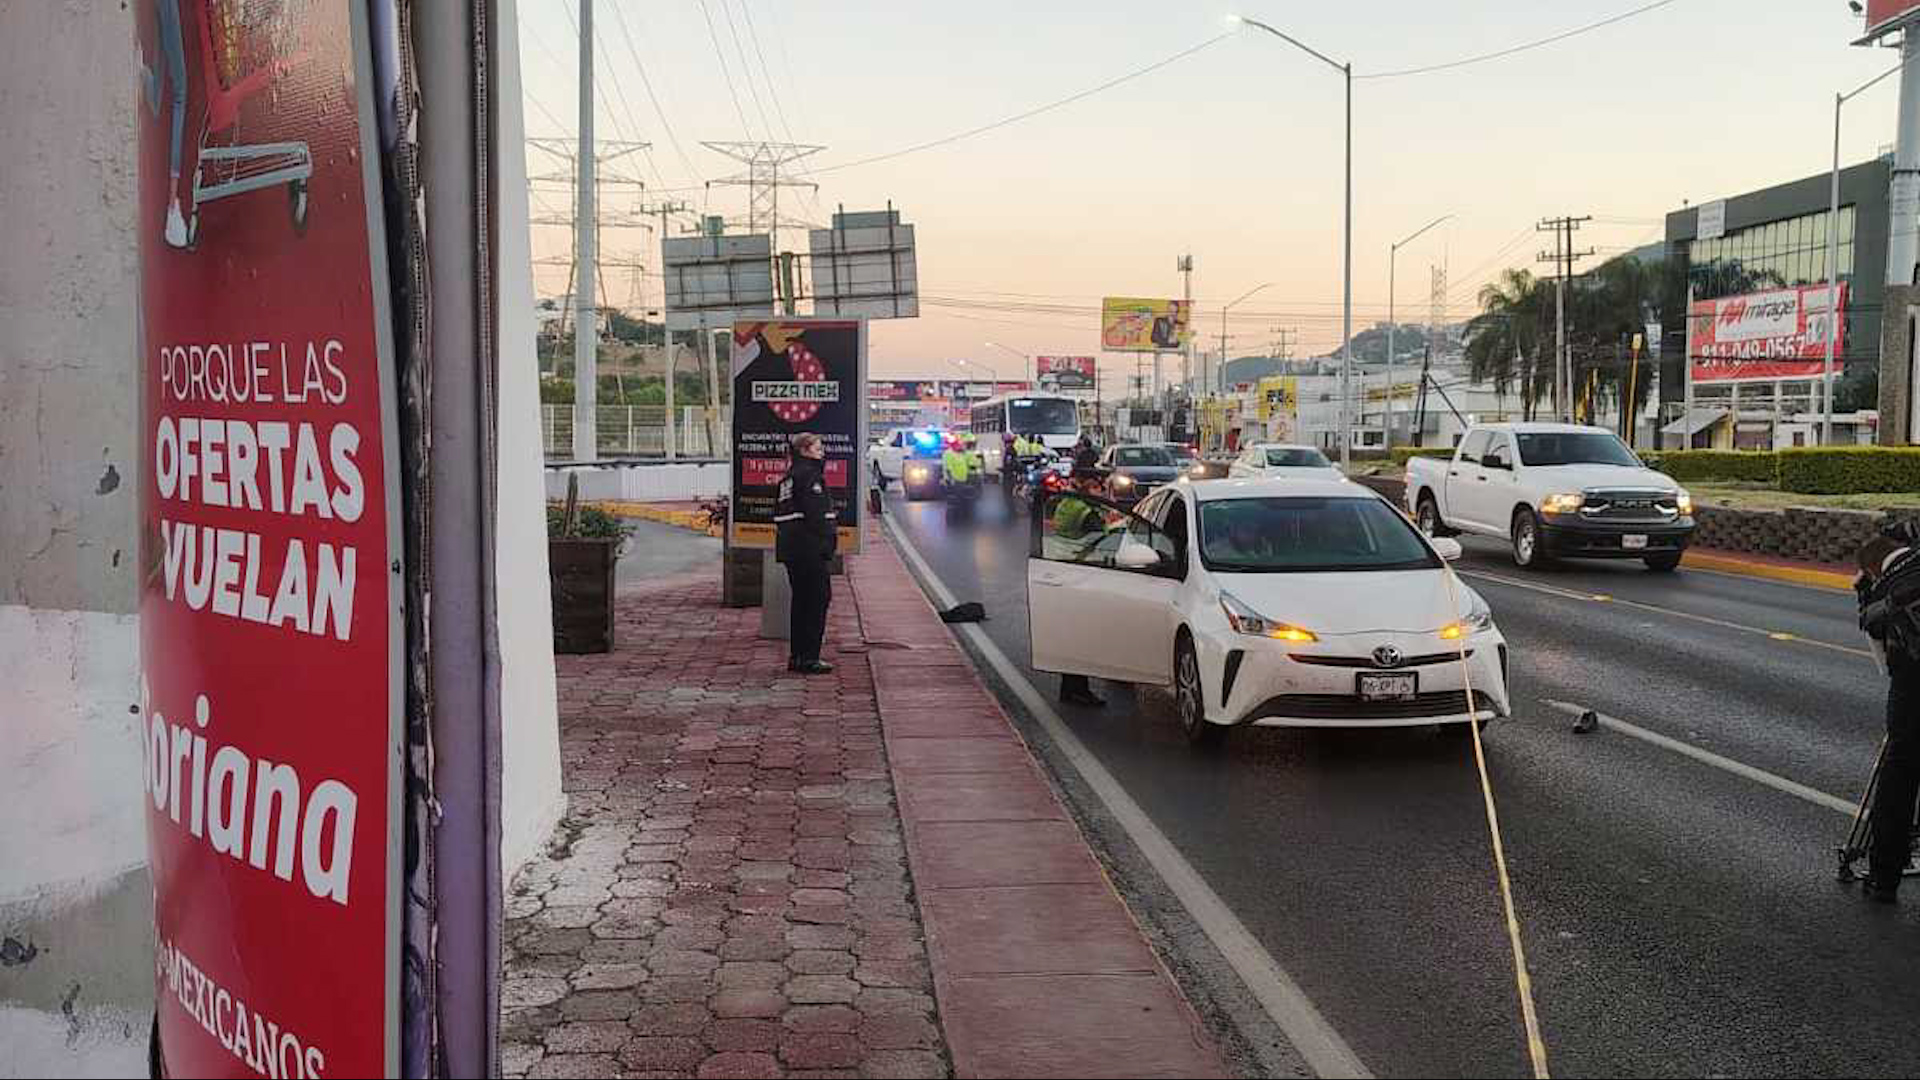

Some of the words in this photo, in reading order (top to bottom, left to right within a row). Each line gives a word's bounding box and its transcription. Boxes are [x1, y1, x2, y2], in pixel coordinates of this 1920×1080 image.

[1745, 301, 1796, 322] mirage
[160, 342, 273, 404] PORQUE
[280, 339, 347, 405] LAS
[754, 382, 799, 399] PIZZA
[803, 382, 839, 399] MEX
[156, 415, 365, 523] OFERTAS
[160, 519, 357, 641] VUELAN
